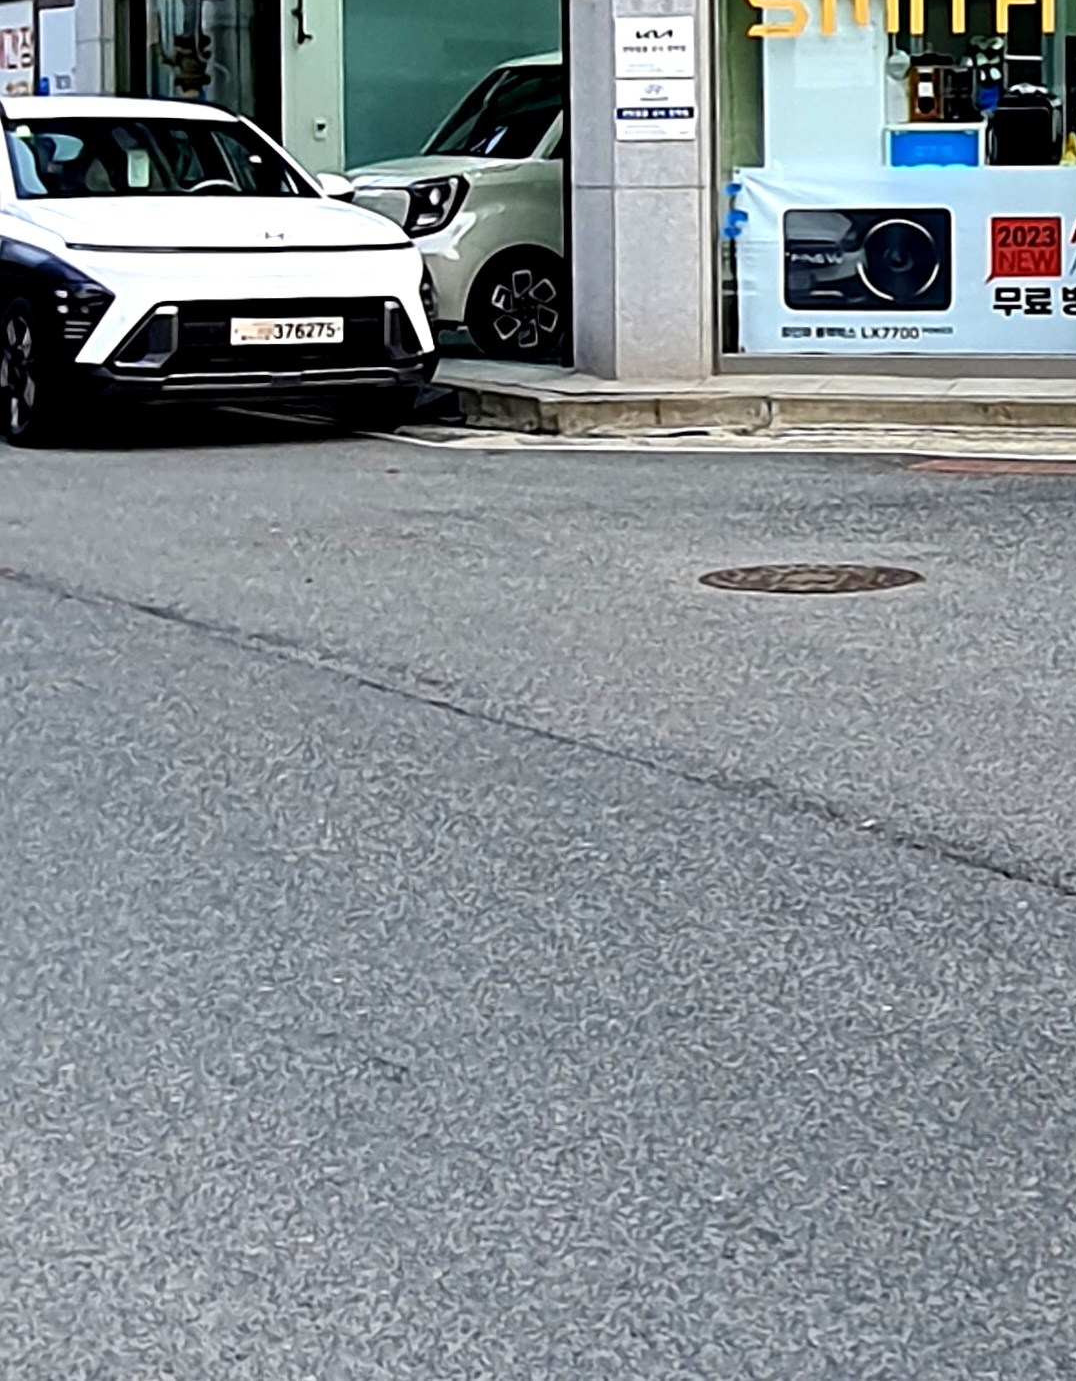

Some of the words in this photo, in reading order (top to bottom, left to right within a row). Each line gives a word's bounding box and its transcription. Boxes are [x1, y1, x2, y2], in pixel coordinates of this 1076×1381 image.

[997, 226, 1056, 248] 2023
[999, 249, 1055, 272] NEW
[993, 286, 1053, 316] 무료
[273, 322, 335, 339] 376275
[861, 327, 919, 339] LX7700
